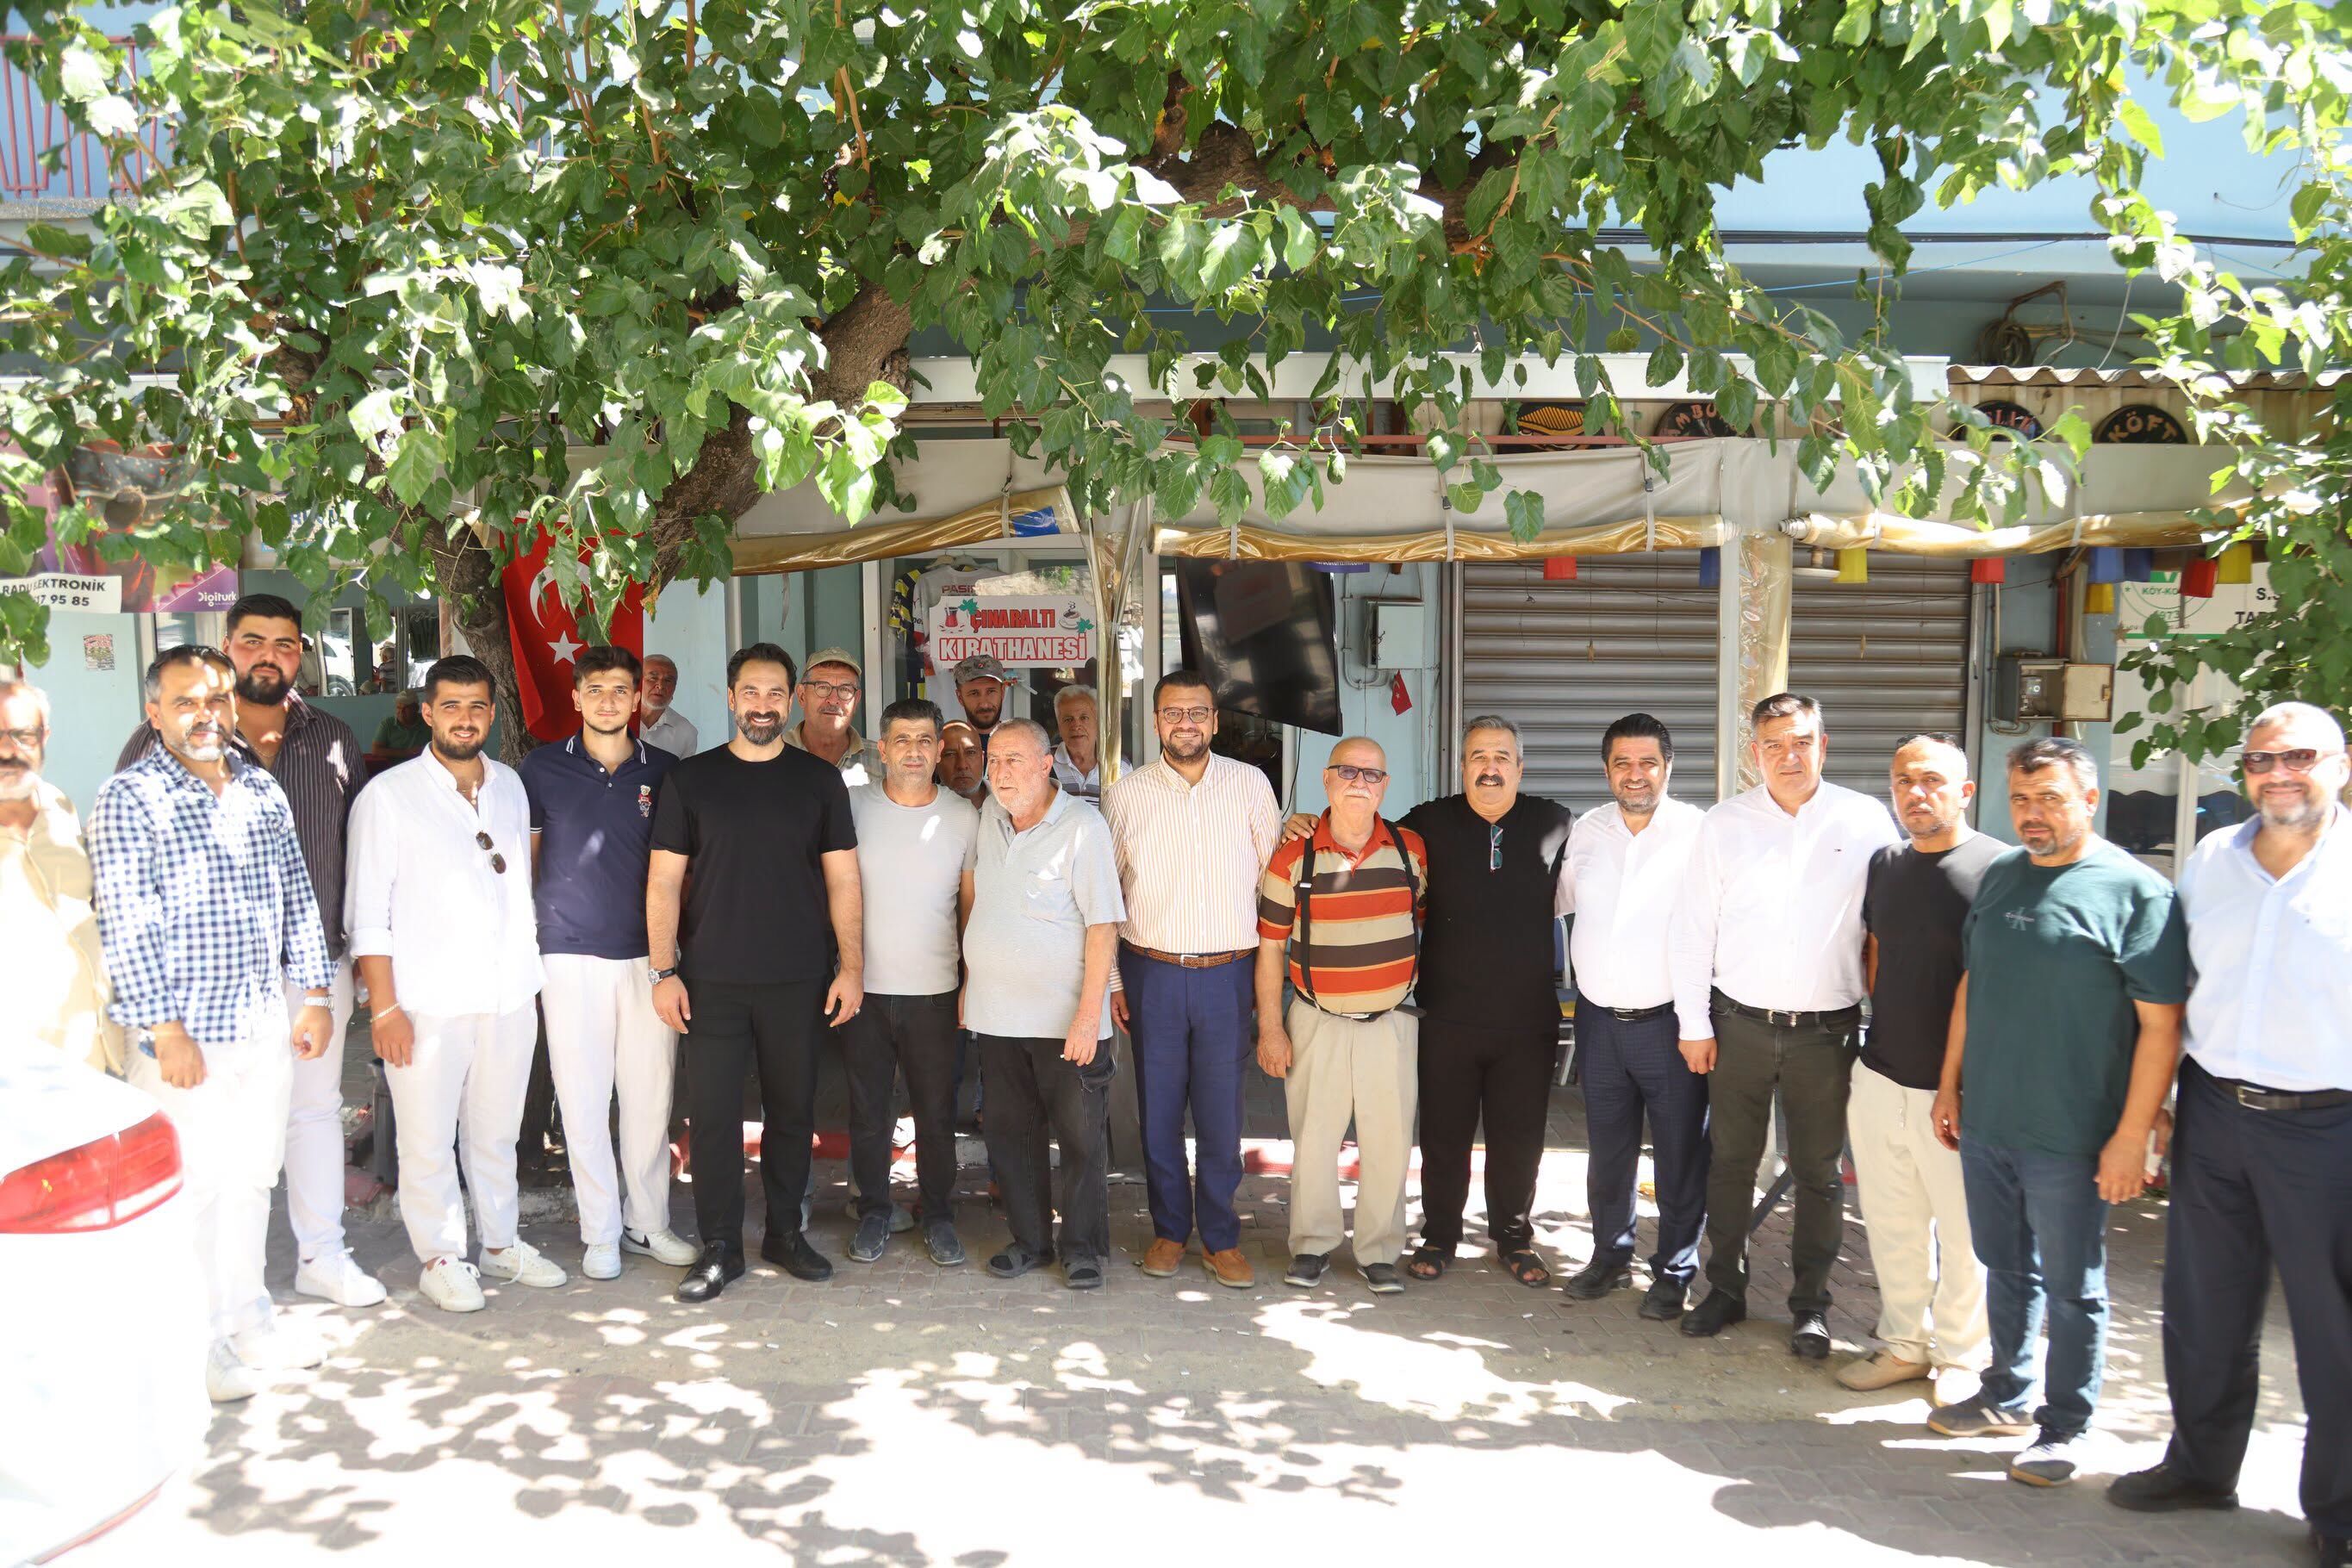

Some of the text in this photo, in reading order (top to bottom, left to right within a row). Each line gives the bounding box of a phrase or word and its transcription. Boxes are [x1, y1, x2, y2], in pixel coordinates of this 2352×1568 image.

[2108, 411, 2178, 441] KÖFT
[50, 594, 66, 605] 95
[72, 596, 90, 607] 85
[198, 591, 237, 607] Digiturk
[970, 608, 1055, 634] ÇINARALTI
[939, 632, 1087, 661] KIRATHANESİ
